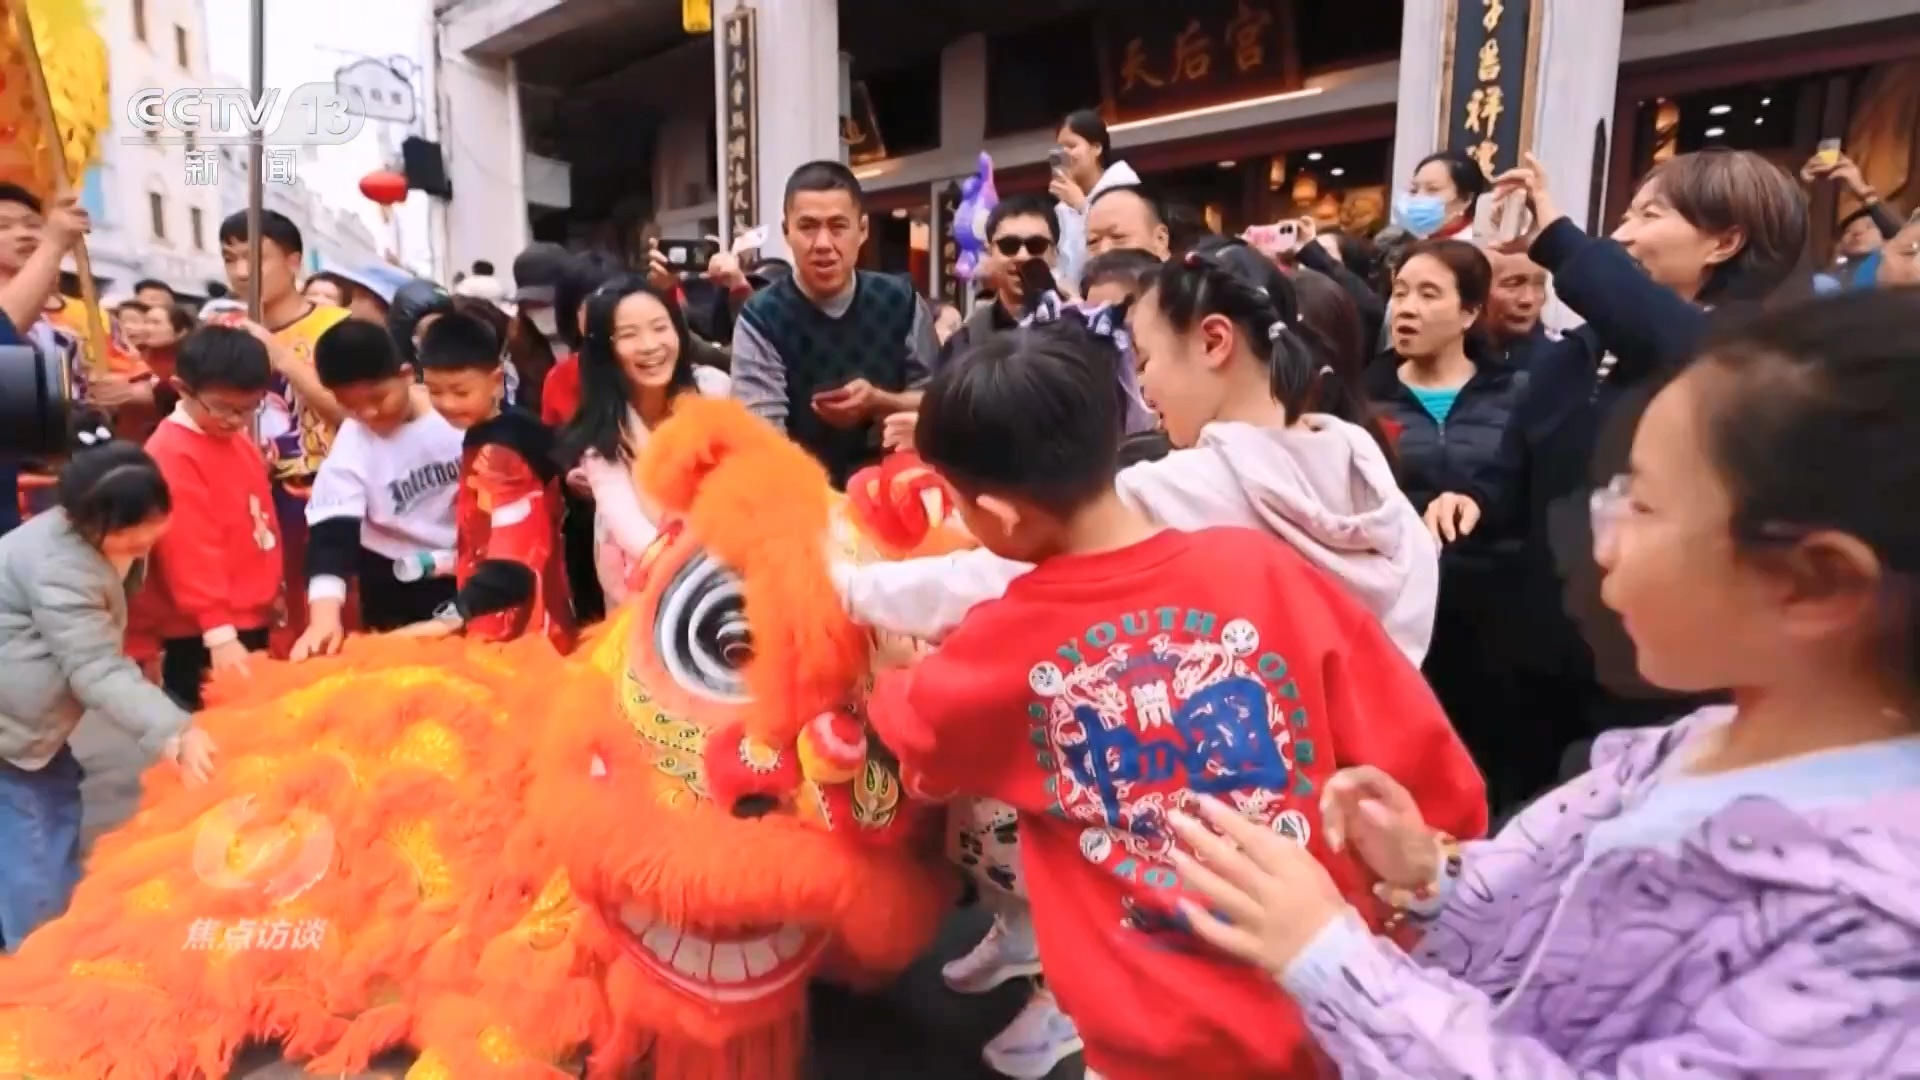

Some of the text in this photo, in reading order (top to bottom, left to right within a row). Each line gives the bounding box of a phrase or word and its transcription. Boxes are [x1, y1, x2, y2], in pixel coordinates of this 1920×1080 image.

[1119, 2, 1274, 94] 天后宫
[1056, 606, 1217, 663] YOUTH
